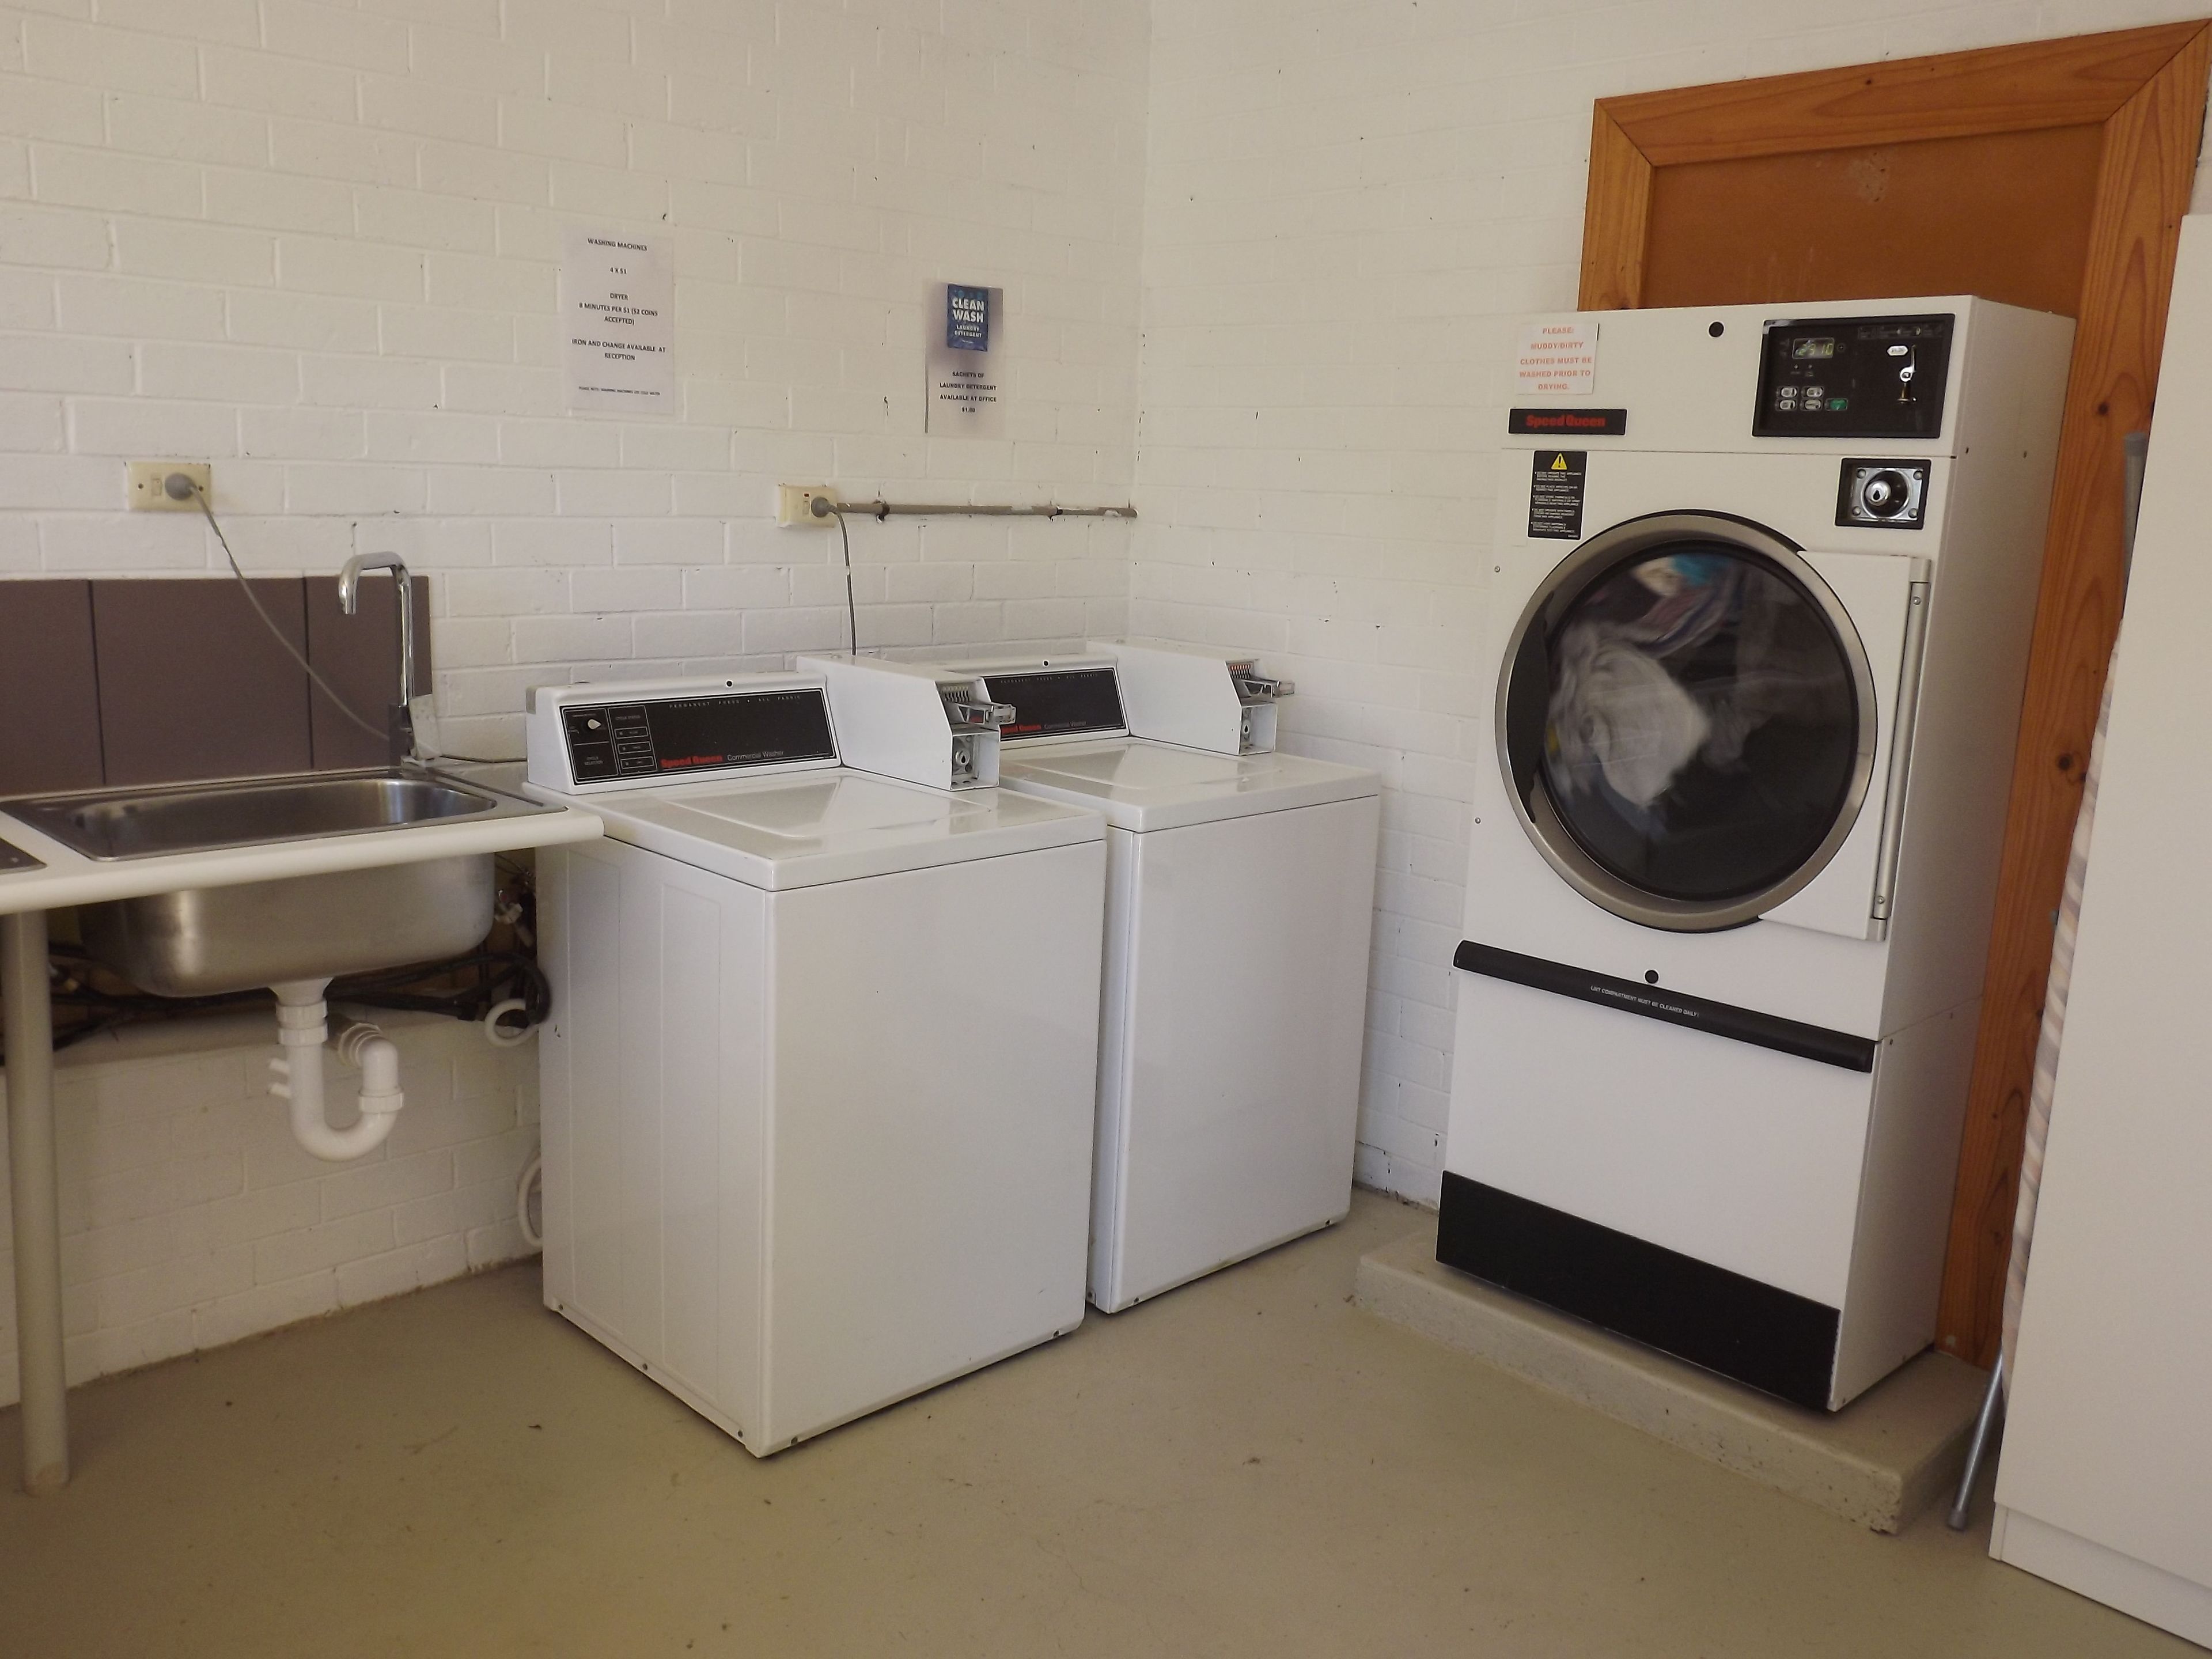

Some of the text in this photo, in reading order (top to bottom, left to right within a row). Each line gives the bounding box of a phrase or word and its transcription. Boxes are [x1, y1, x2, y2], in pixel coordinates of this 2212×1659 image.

[587, 238, 647, 251] WASHING MACHINES
[584, 303, 610, 311] MINUTES
[952, 297, 984, 311] CLEAN
[604, 316, 635, 325] ACCEPTED)
[952, 309, 984, 323] WASH
[627, 344, 656, 352] AVAILABLE
[604, 353, 635, 361] RECEPTION
[1526, 414, 1605, 428] Speed Queen
[727, 753, 761, 761] Commercial
[1659, 1003, 1683, 1013] CLEANED
